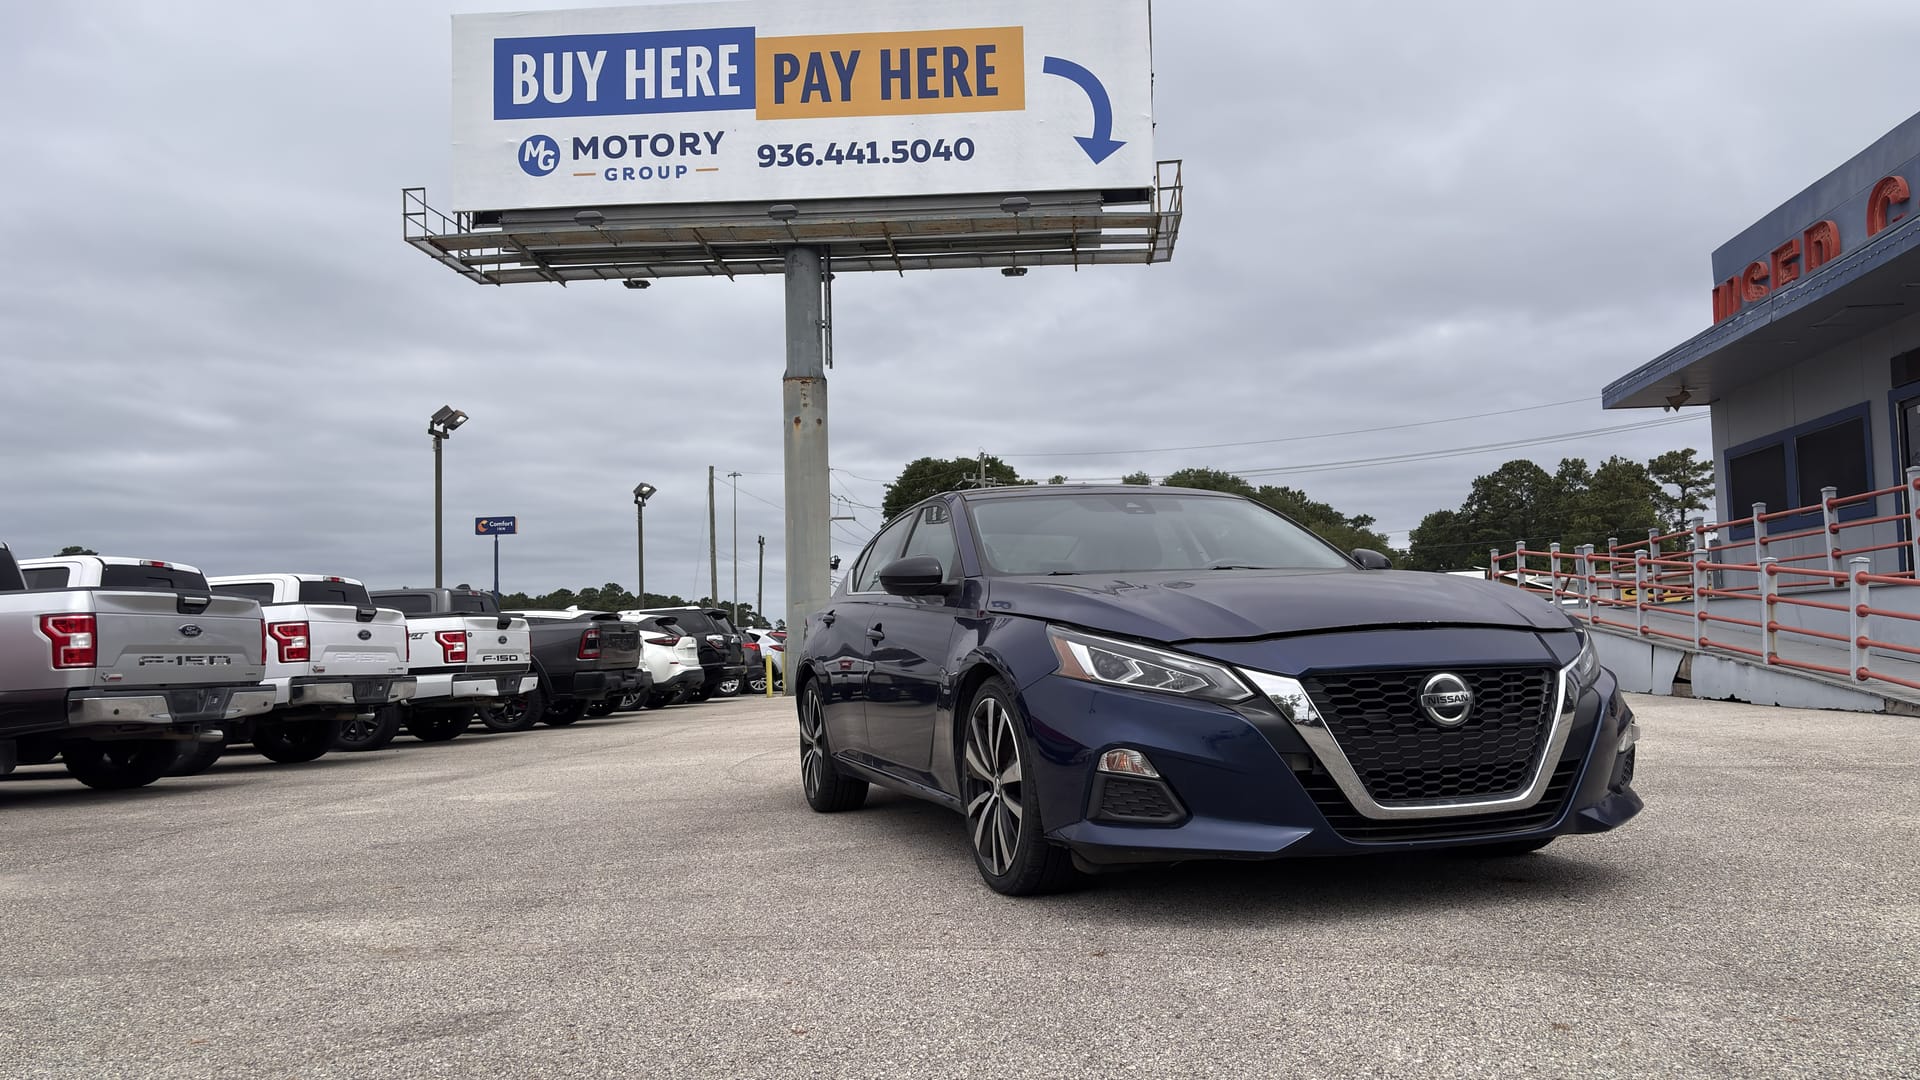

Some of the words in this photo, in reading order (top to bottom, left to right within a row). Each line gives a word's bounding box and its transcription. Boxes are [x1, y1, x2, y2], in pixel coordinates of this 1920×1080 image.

[511, 50, 608, 106] BUY
[625, 43, 741, 101] HERE
[773, 50, 861, 106] PAY
[880, 44, 999, 100] HERE
[523, 139, 558, 173] MG
[572, 131, 725, 160] MOTORY
[756, 137, 976, 168] 936.441.5040
[603, 164, 689, 182] GROUP
[1712, 219, 1842, 327] USED
[482, 654, 519, 662] F-150
[1428, 695, 1468, 704] NISSAN
